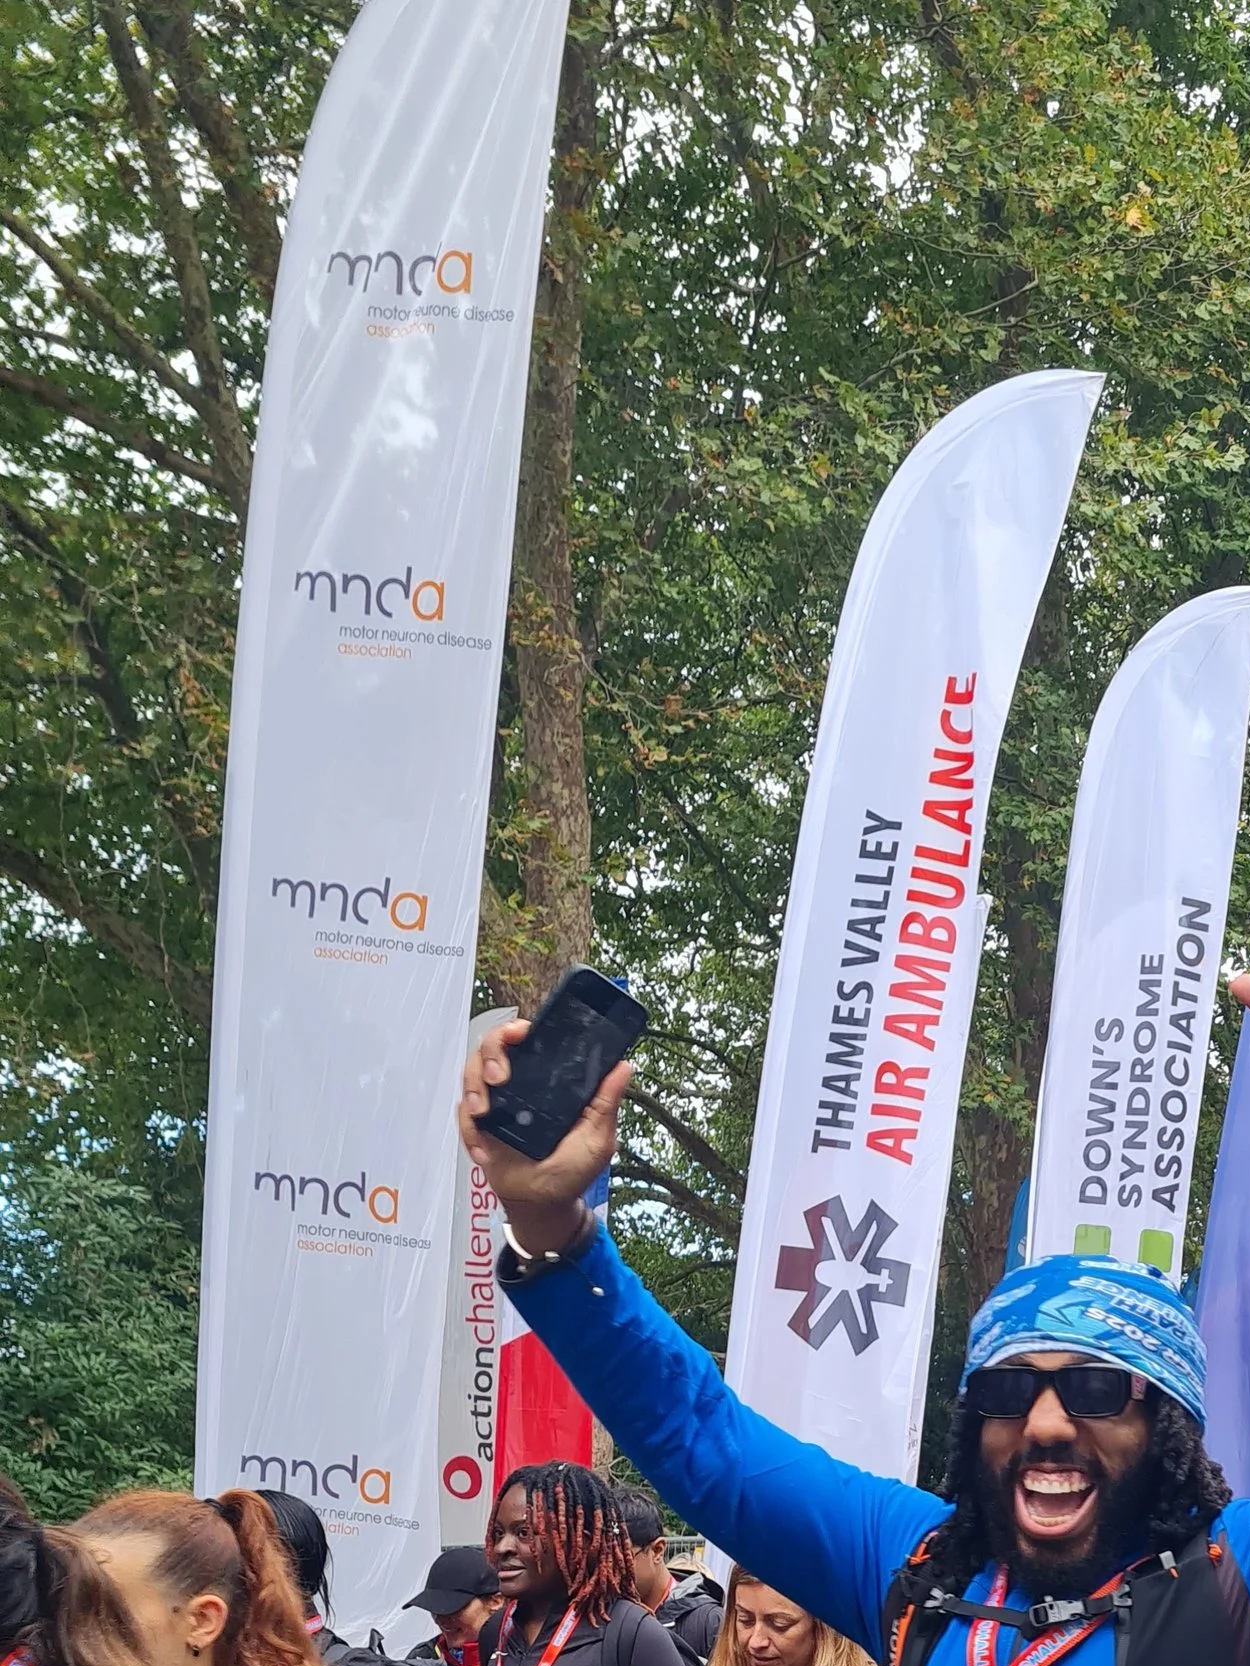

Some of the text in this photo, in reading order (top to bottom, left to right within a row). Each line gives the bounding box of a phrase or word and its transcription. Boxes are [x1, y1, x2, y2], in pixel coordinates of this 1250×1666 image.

[294, 566, 445, 622] mnda
[337, 641, 412, 660] association
[339, 625, 493, 651] motor neurone disease
[271, 877, 428, 932] mnda
[866, 671, 978, 1166] AIR AMBULANCE
[314, 946, 389, 966] association
[315, 929, 465, 958] motor neurone disease
[812, 808, 903, 1155] THAMES VALLEY
[1118, 953, 1165, 1209] SYNDROME
[1151, 897, 1212, 1214] ASSOCIATION
[1079, 1017, 1125, 1207] DOWN'S
[254, 1170, 400, 1225] mnda
[297, 1223, 337, 1239] motor
[338, 1226, 393, 1243] neurone
[297, 1238, 373, 1258] association
[241, 1454, 391, 1506] mnda
[328, 1508, 382, 1526] neurone
